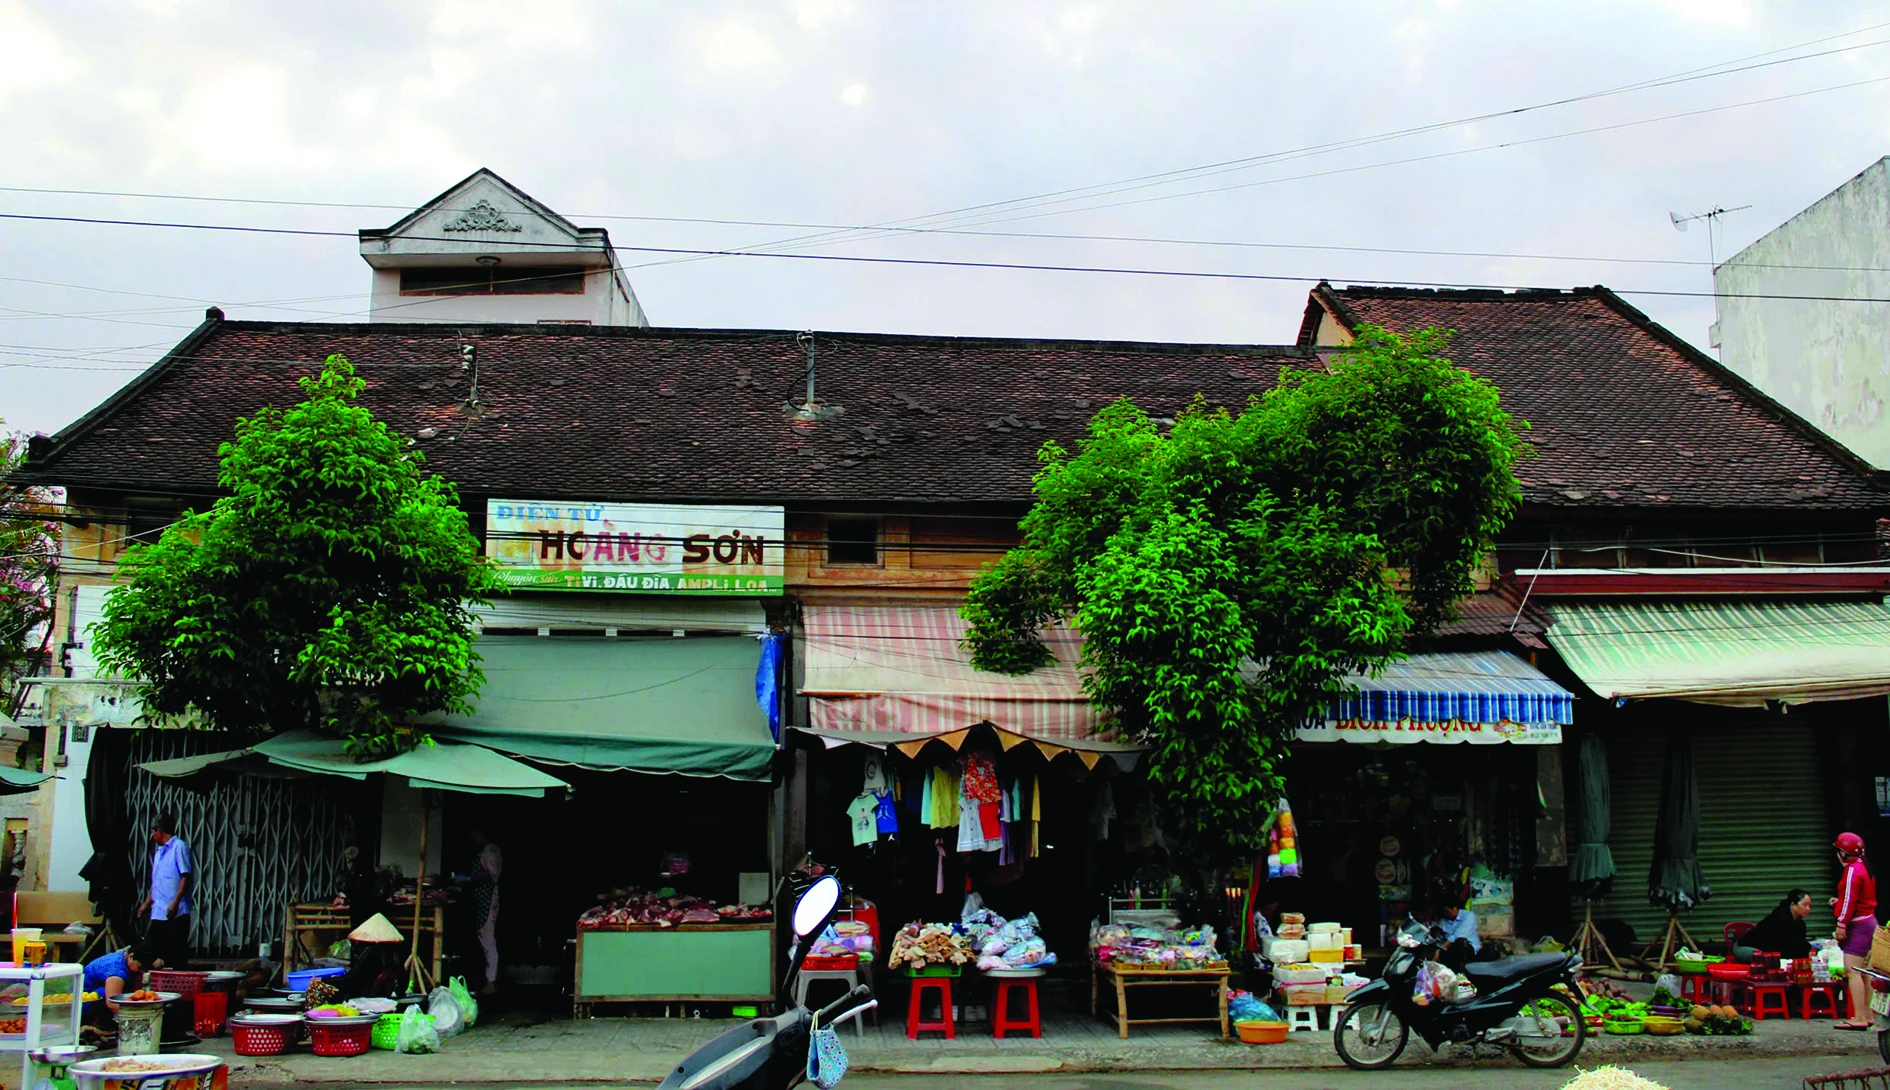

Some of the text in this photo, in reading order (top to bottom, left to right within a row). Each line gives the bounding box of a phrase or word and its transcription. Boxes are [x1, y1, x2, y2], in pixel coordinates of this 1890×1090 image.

[496, 502, 560, 523] ĐIỆN
[538, 519, 764, 565] HOÀNG SƠN
